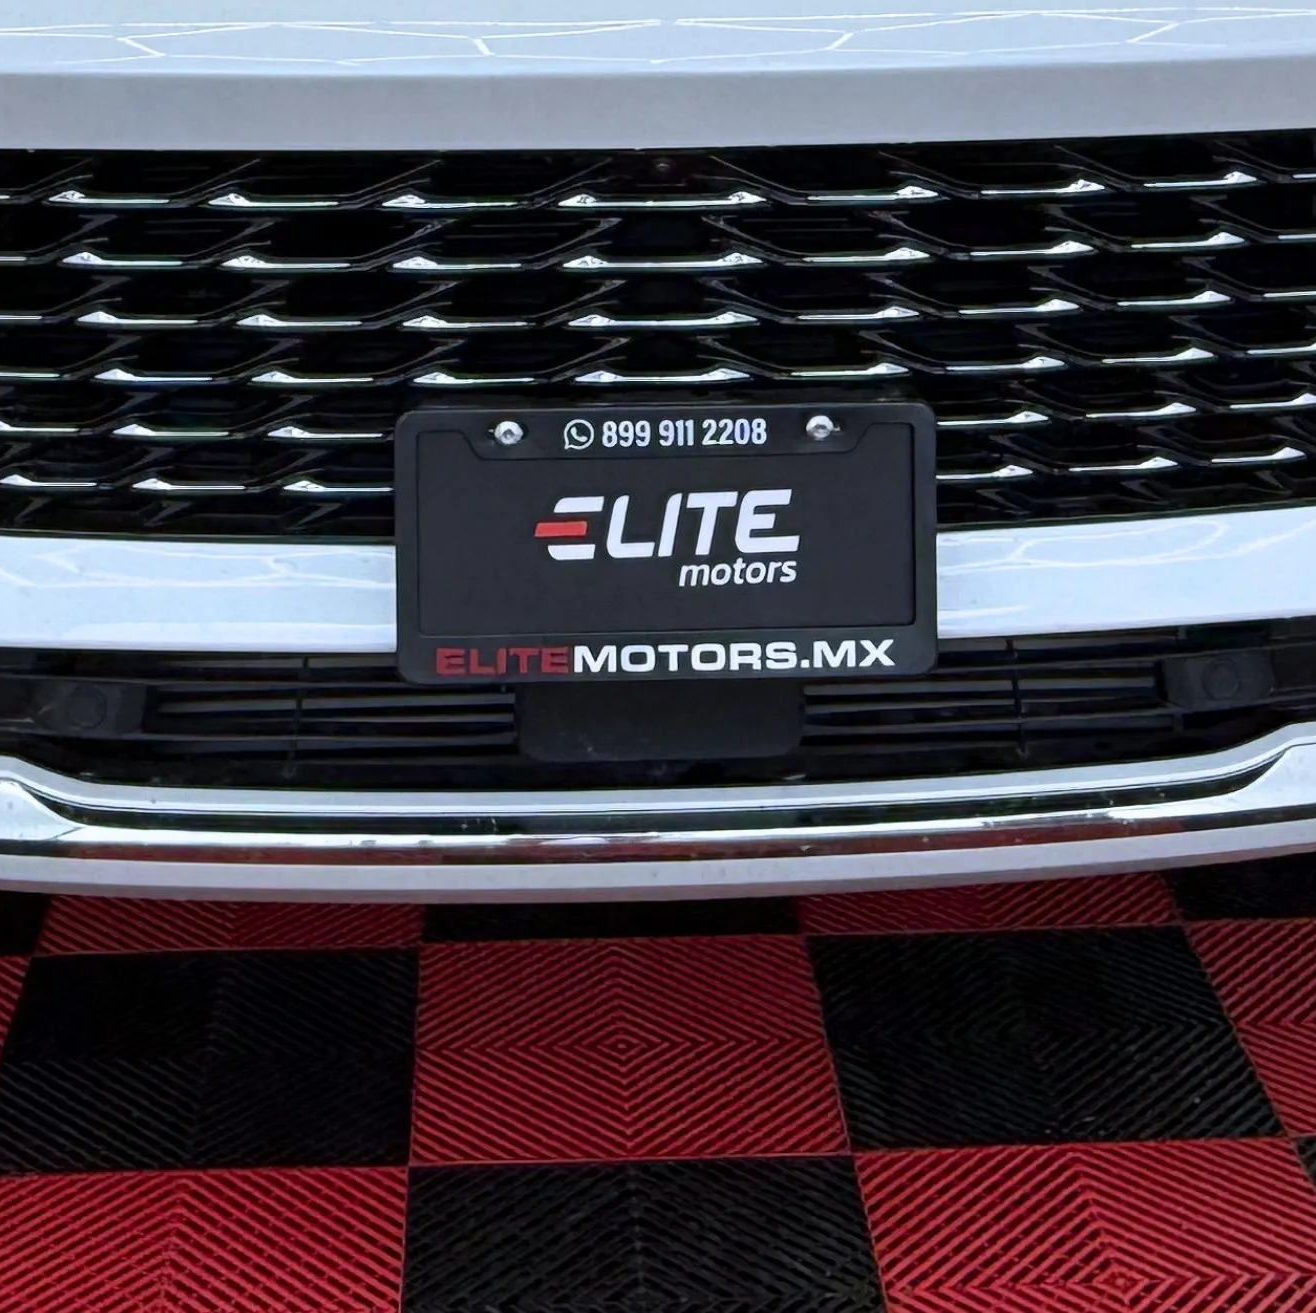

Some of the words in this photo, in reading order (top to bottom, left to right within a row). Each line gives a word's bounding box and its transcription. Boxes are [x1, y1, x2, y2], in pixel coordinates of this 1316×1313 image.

[601, 419, 651, 448] 899
[658, 418, 694, 447] 911
[701, 417, 768, 446] 2208
[533, 488, 801, 561] ELITE
[678, 555, 798, 588] motors
[434, 637, 896, 677] ELITEMOTORS.MX
